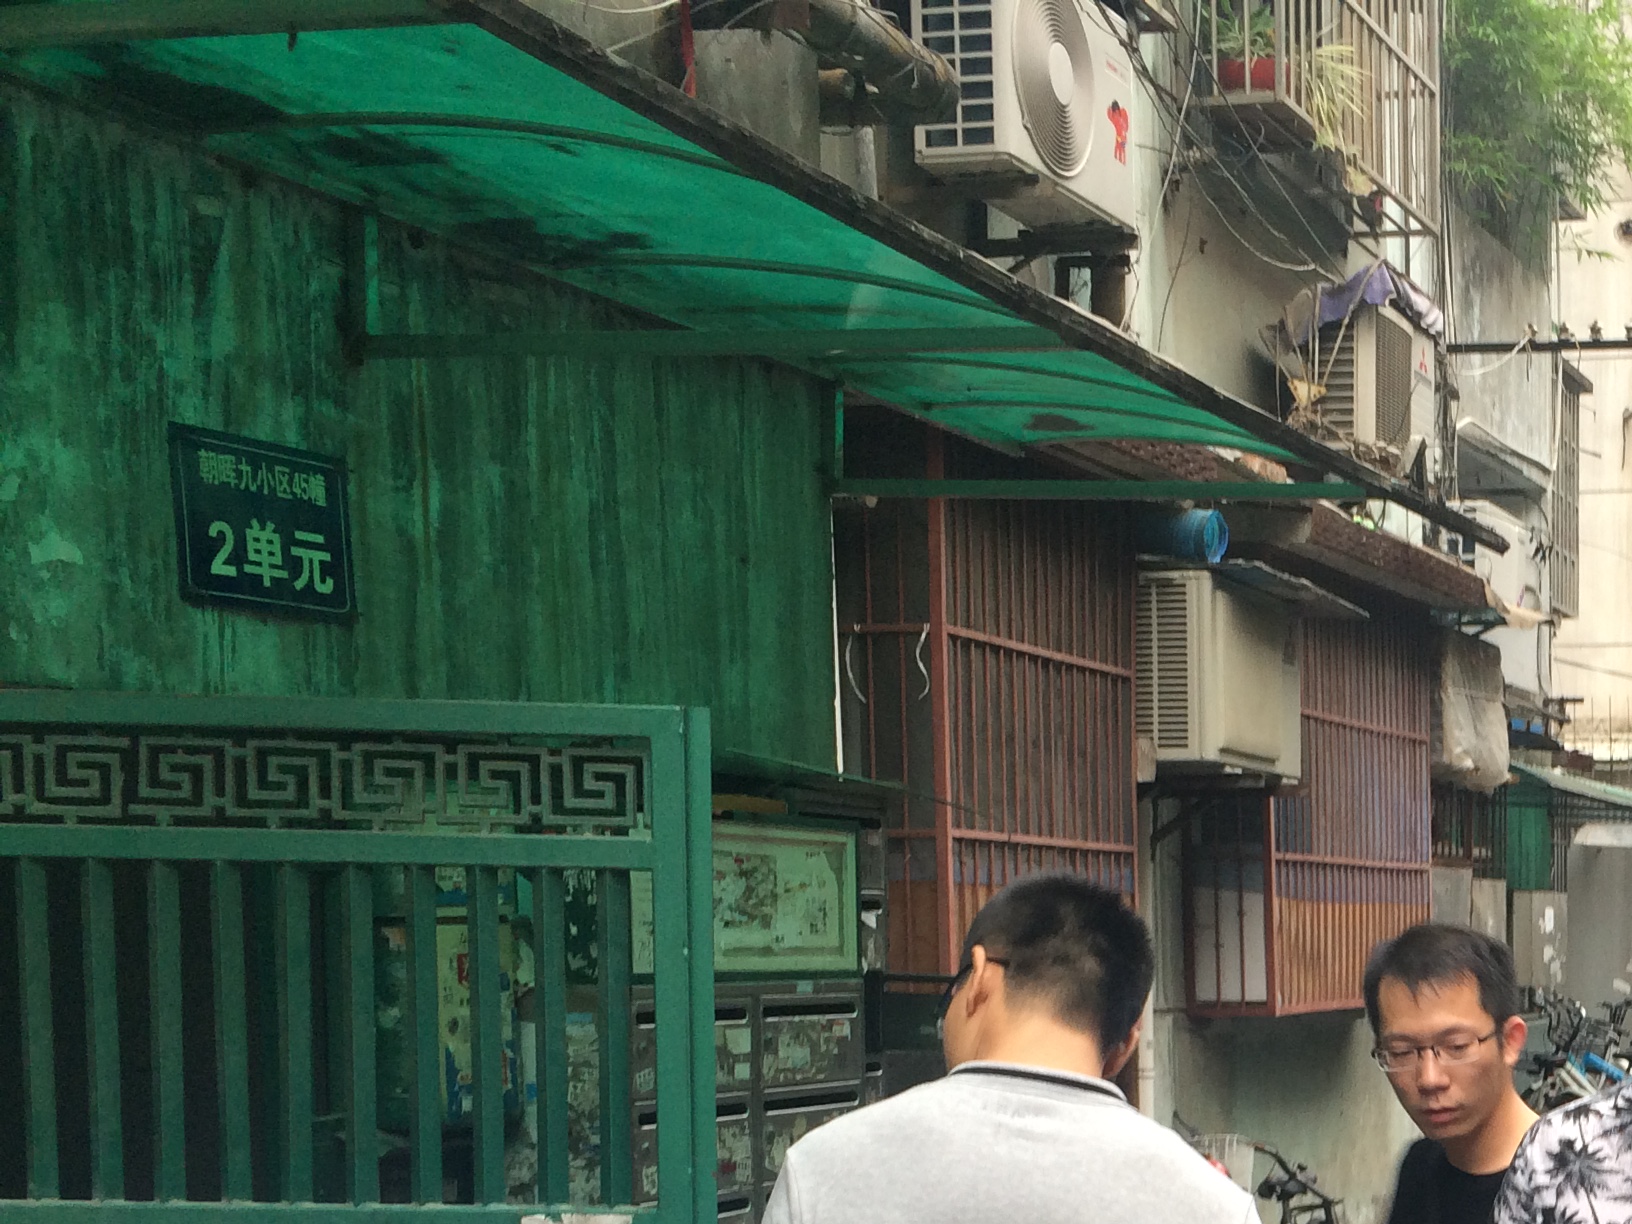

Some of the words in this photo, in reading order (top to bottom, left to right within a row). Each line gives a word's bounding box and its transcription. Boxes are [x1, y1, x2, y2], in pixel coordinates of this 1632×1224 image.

[198, 449, 327, 507] 朝晖九小区45幢
[208, 518, 334, 594] 2单元
